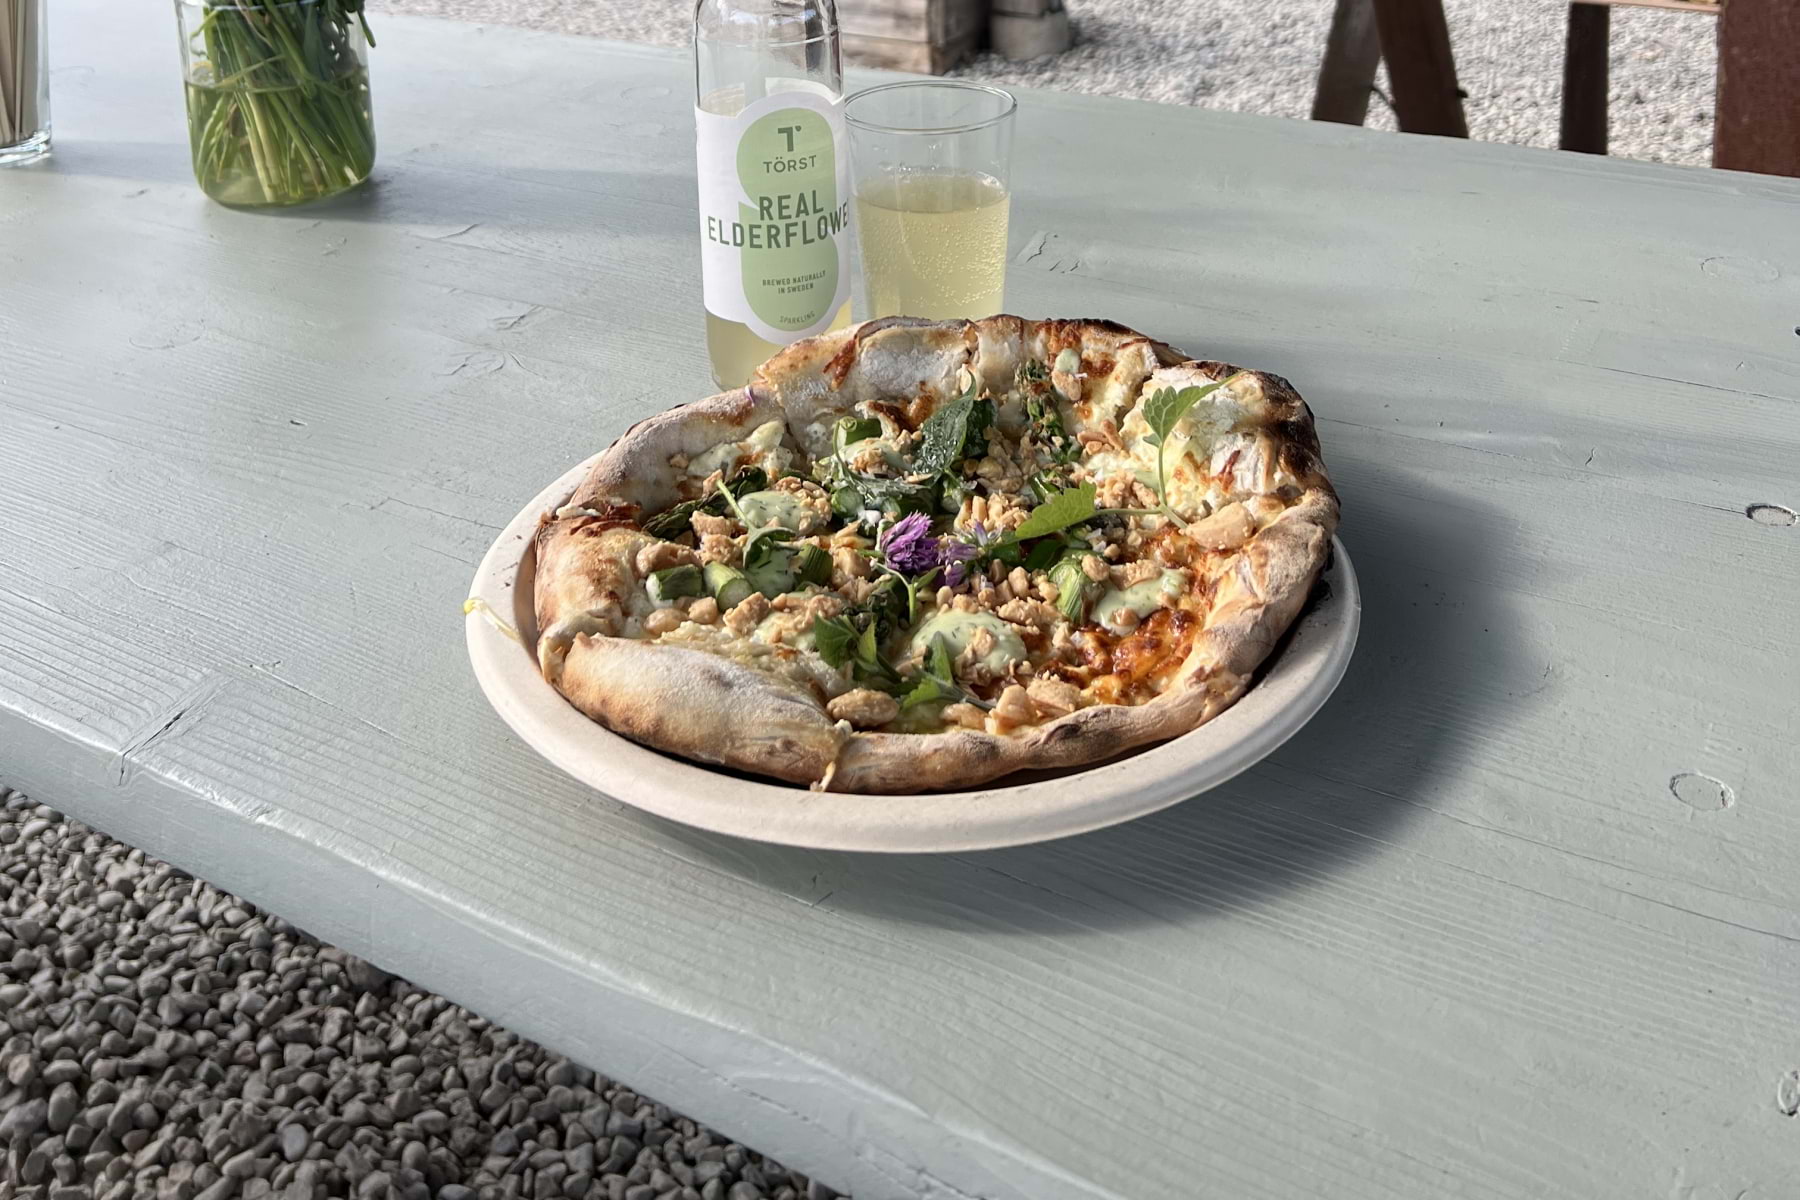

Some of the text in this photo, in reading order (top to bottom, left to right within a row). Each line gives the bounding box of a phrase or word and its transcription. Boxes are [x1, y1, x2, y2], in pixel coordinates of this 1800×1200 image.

[763, 155, 817, 173] TÖRST
[759, 190, 824, 221] REAL
[707, 198, 849, 249] ELDERFLOWE
[762, 270, 826, 287] BREWED NATURALLY
[787, 283, 814, 294] SWEDEN
[779, 311, 816, 324] SPARKLING
